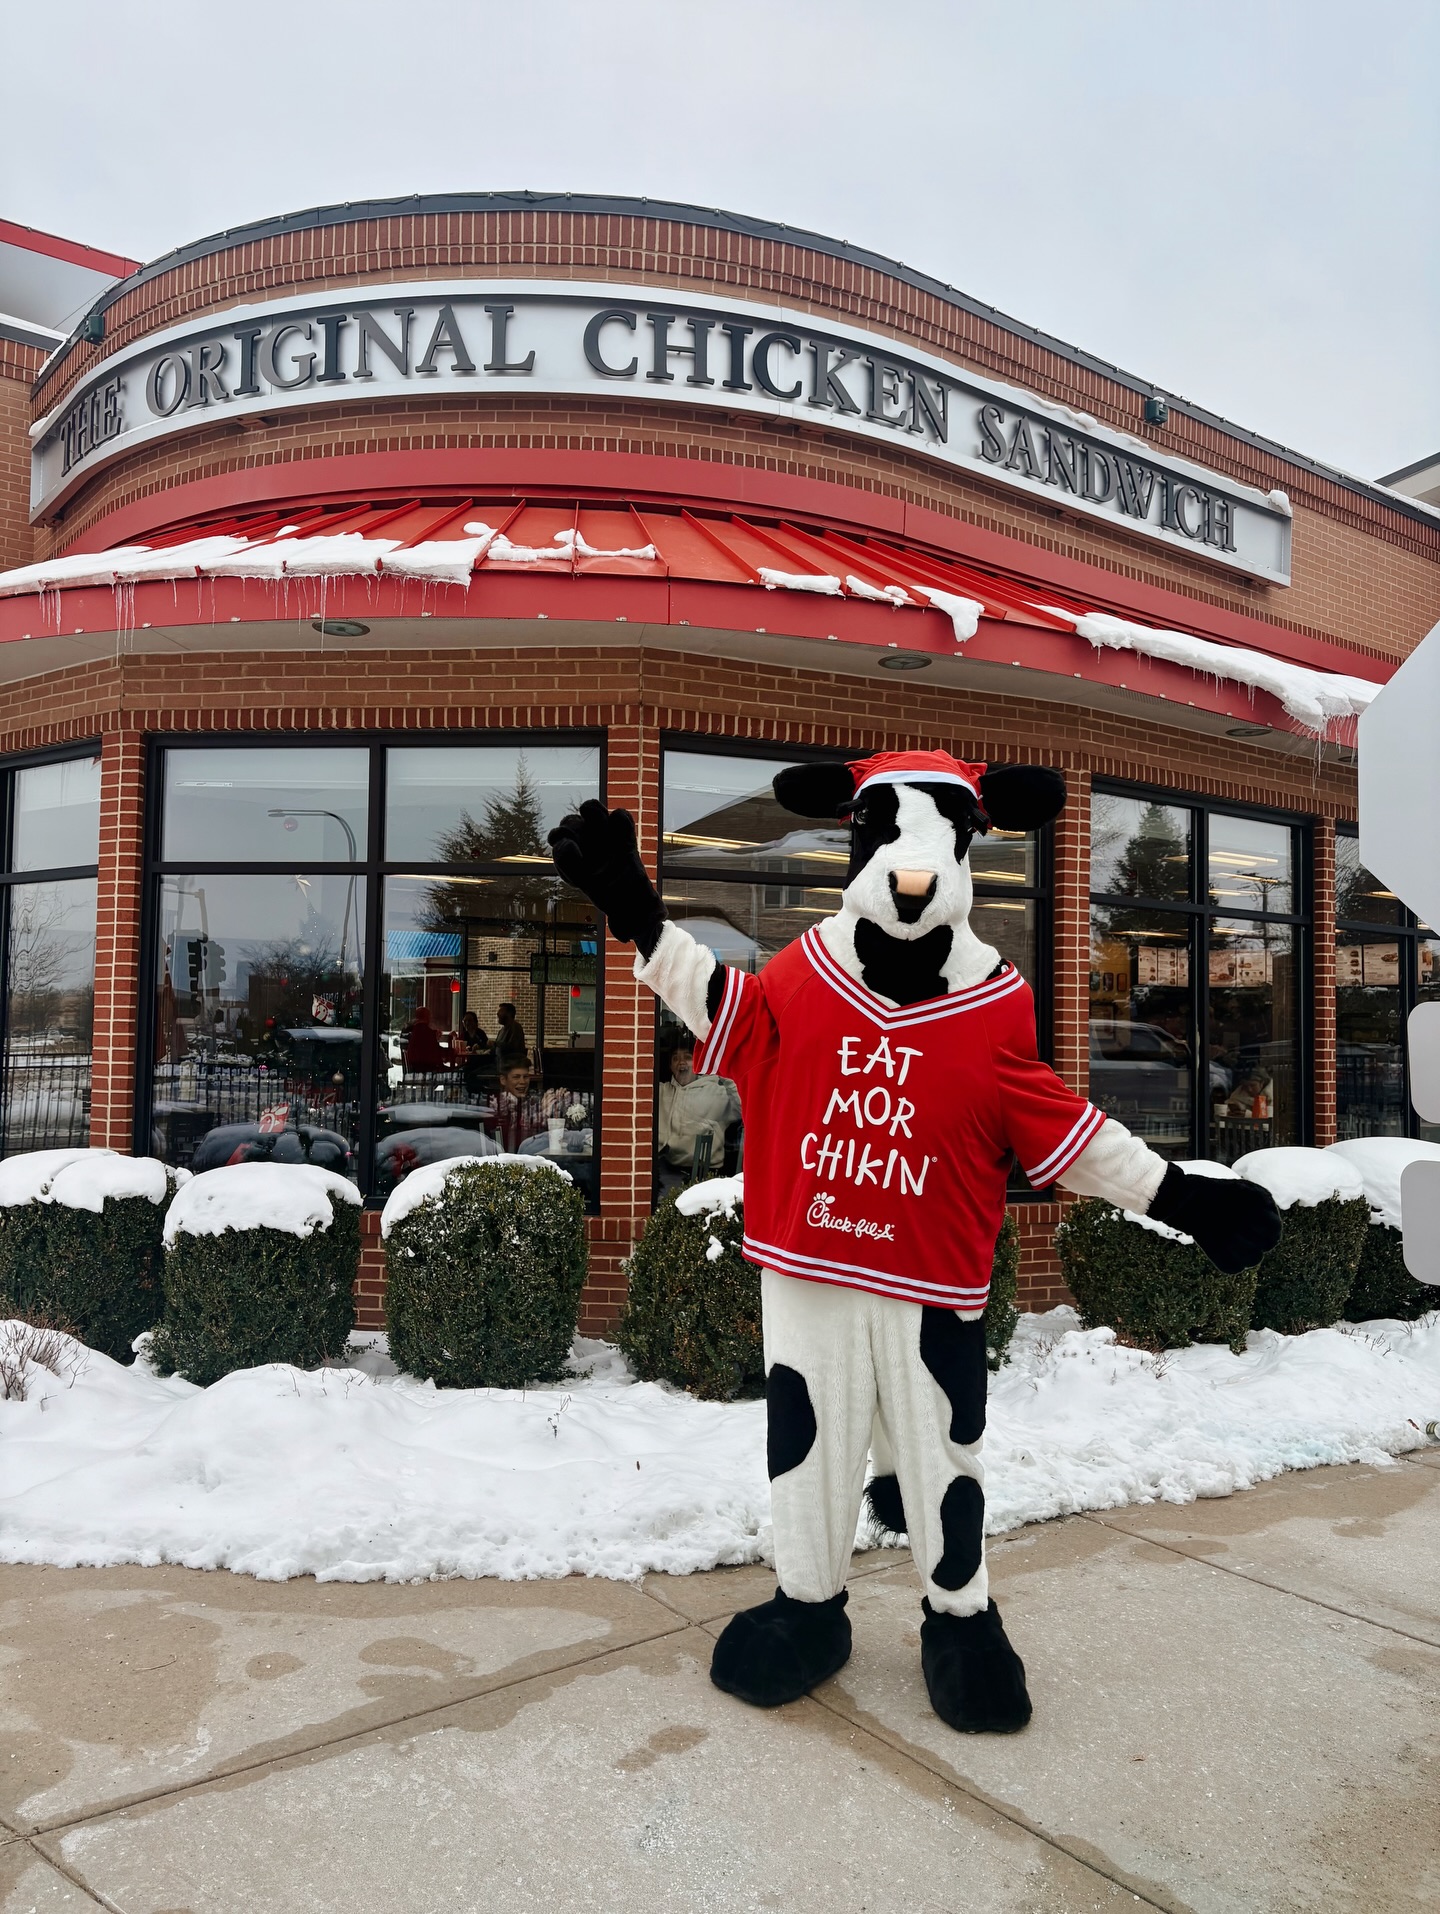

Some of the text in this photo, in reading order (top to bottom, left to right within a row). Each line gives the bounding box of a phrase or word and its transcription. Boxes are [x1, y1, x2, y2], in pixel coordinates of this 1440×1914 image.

[60, 303, 1238, 552] THE ORIGINAL CHICKEN SANDWICH
[837, 1036, 924, 1086] EAT
[822, 1086, 916, 1139] MOR
[806, 1191, 895, 1241] Chick-fil-A
